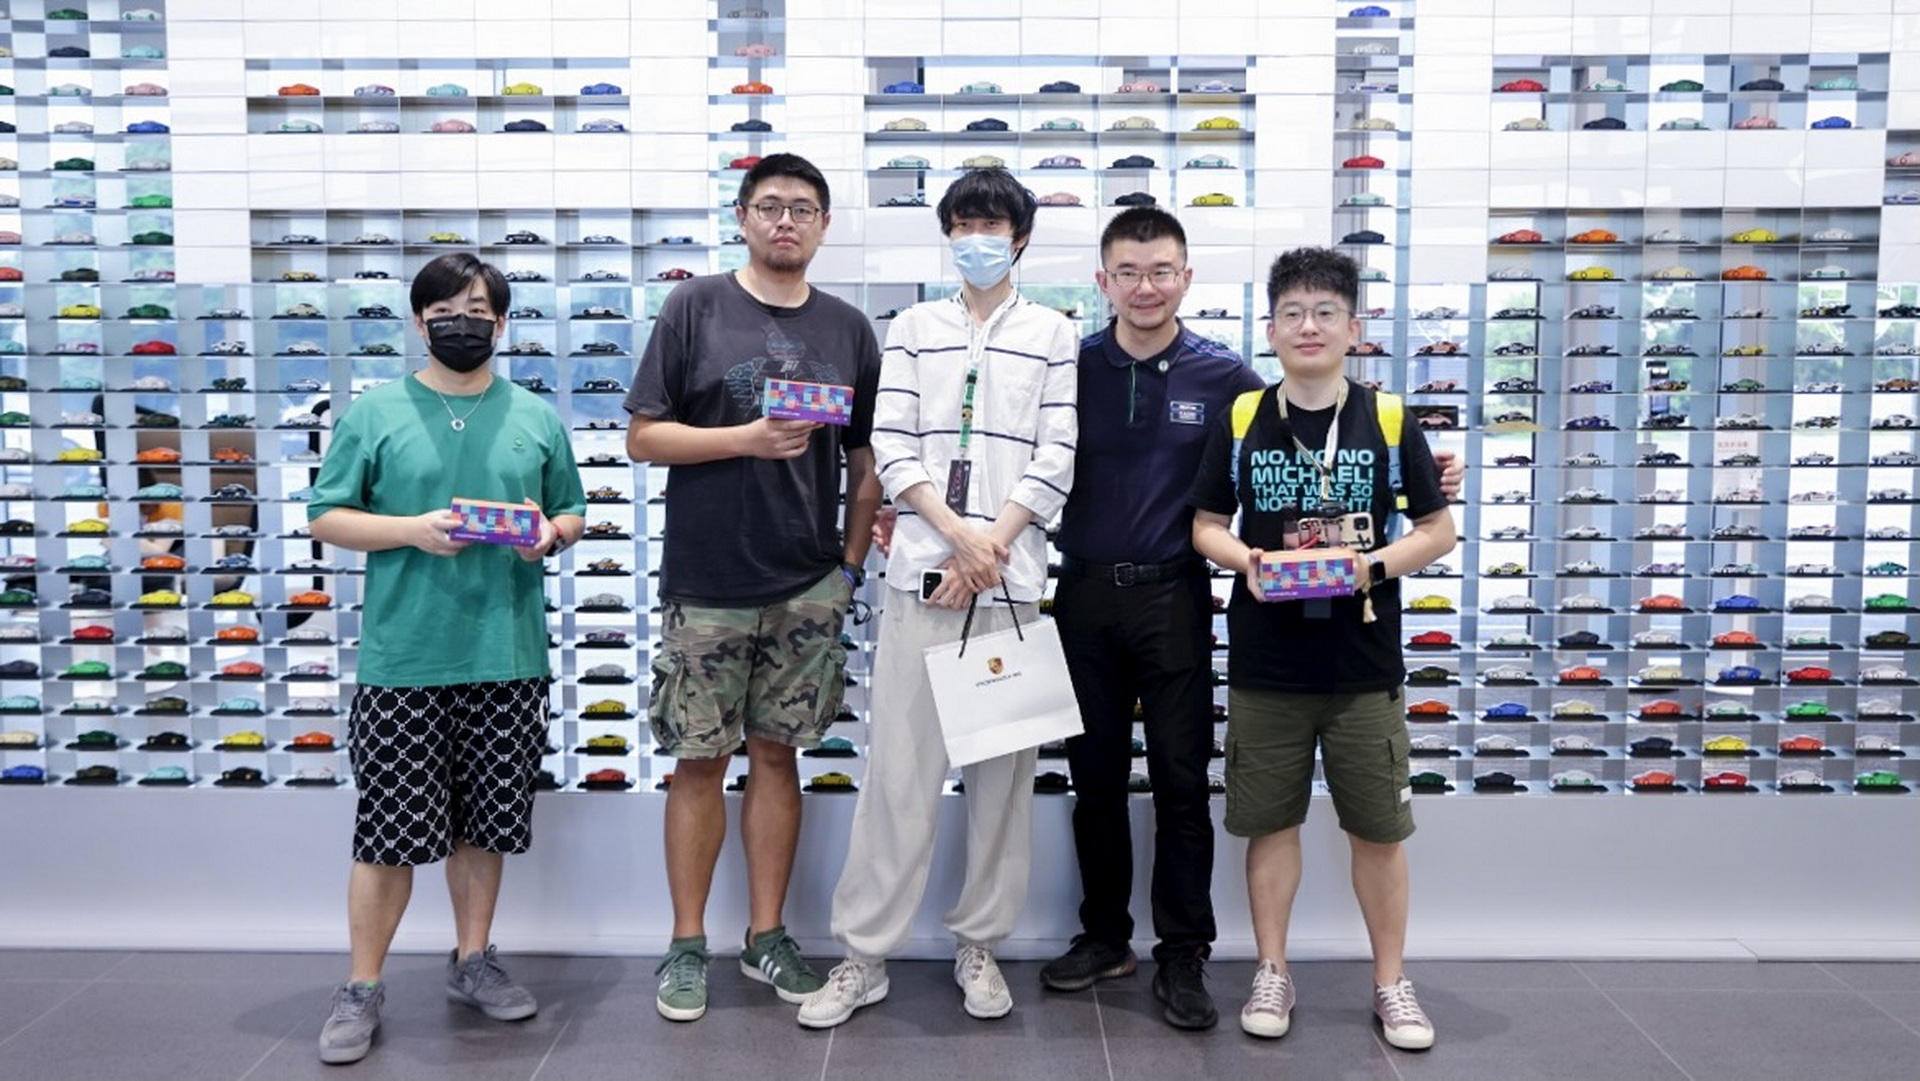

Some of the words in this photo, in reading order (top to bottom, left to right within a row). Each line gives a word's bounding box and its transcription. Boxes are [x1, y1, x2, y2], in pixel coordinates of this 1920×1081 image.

[1251, 449, 1290, 467] NO,
[1337, 449, 1374, 466] NO
[1252, 484, 1299, 497] THAT
[1350, 483, 1373, 498] SO
